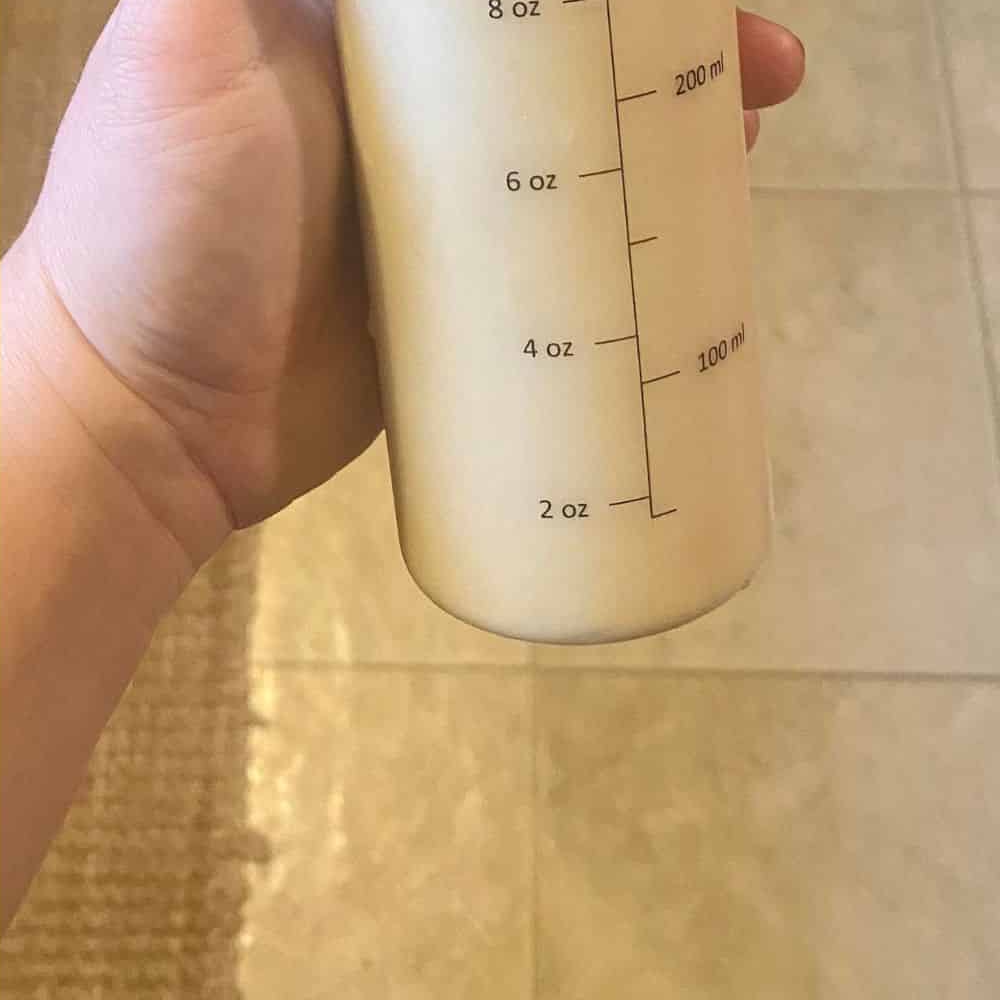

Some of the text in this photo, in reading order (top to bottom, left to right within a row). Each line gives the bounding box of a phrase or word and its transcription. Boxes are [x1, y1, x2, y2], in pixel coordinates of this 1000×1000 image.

[512, 0, 541, 18] oz
[675, 50, 724, 96] 200 ml
[505, 171, 558, 191] 6 oz
[523, 338, 574, 358] 4 oz
[698, 322, 745, 373] 100 ml
[539, 499, 589, 519] 2 oz
